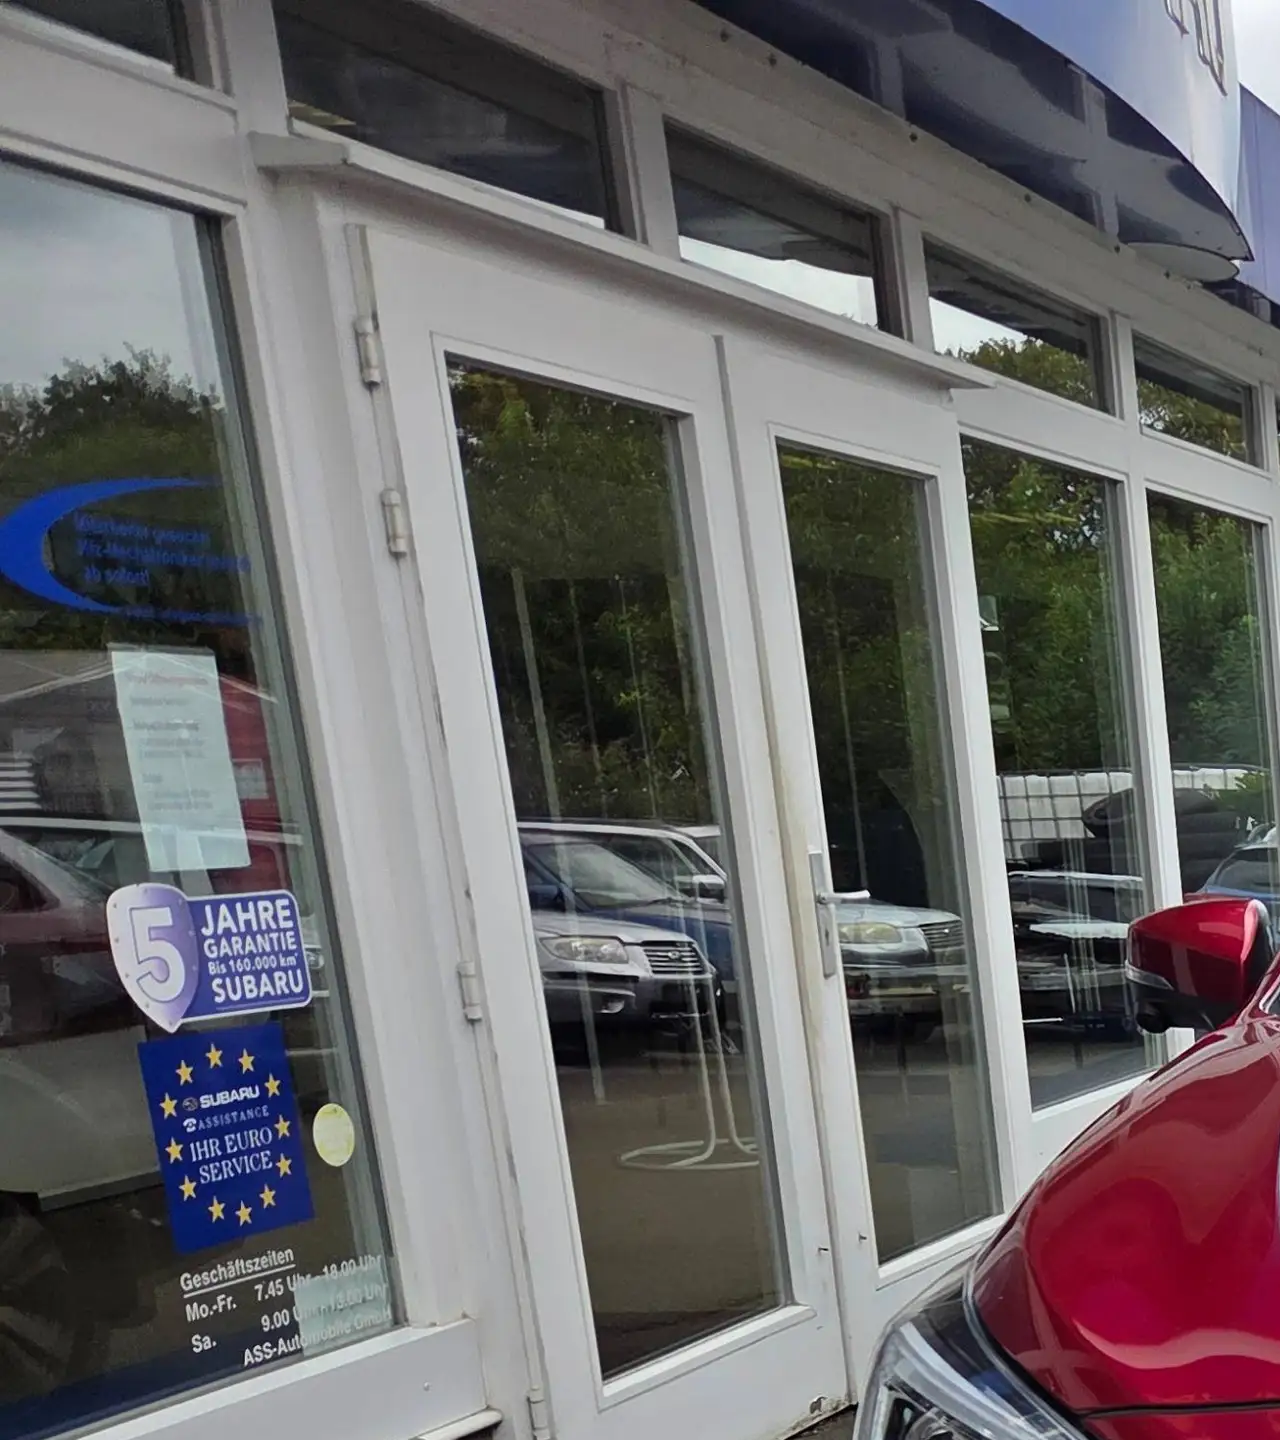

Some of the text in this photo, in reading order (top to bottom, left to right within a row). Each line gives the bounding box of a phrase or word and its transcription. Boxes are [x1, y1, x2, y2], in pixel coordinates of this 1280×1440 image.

[201, 898, 294, 937] JAHRE
[129, 907, 186, 1004] 5
[203, 931, 298, 959] GARANTIE
[208, 961, 226, 976] Bis
[229, 954, 277, 973] 160.000
[211, 969, 304, 1004] SUBARU
[200, 1085, 260, 1109] SUBARU
[198, 1105, 269, 1131] ASSISTANCE
[189, 1127, 273, 1162] IHR EURO
[199, 1150, 273, 1185] SERVICE
[180, 1248, 295, 1291] Geschäftszeiten
[186, 1294, 237, 1322] Mo.-Fr.
[255, 1279, 284, 1302] 7.45
[191, 1334, 217, 1354] Sa.
[261, 1308, 290, 1332] 9.00
